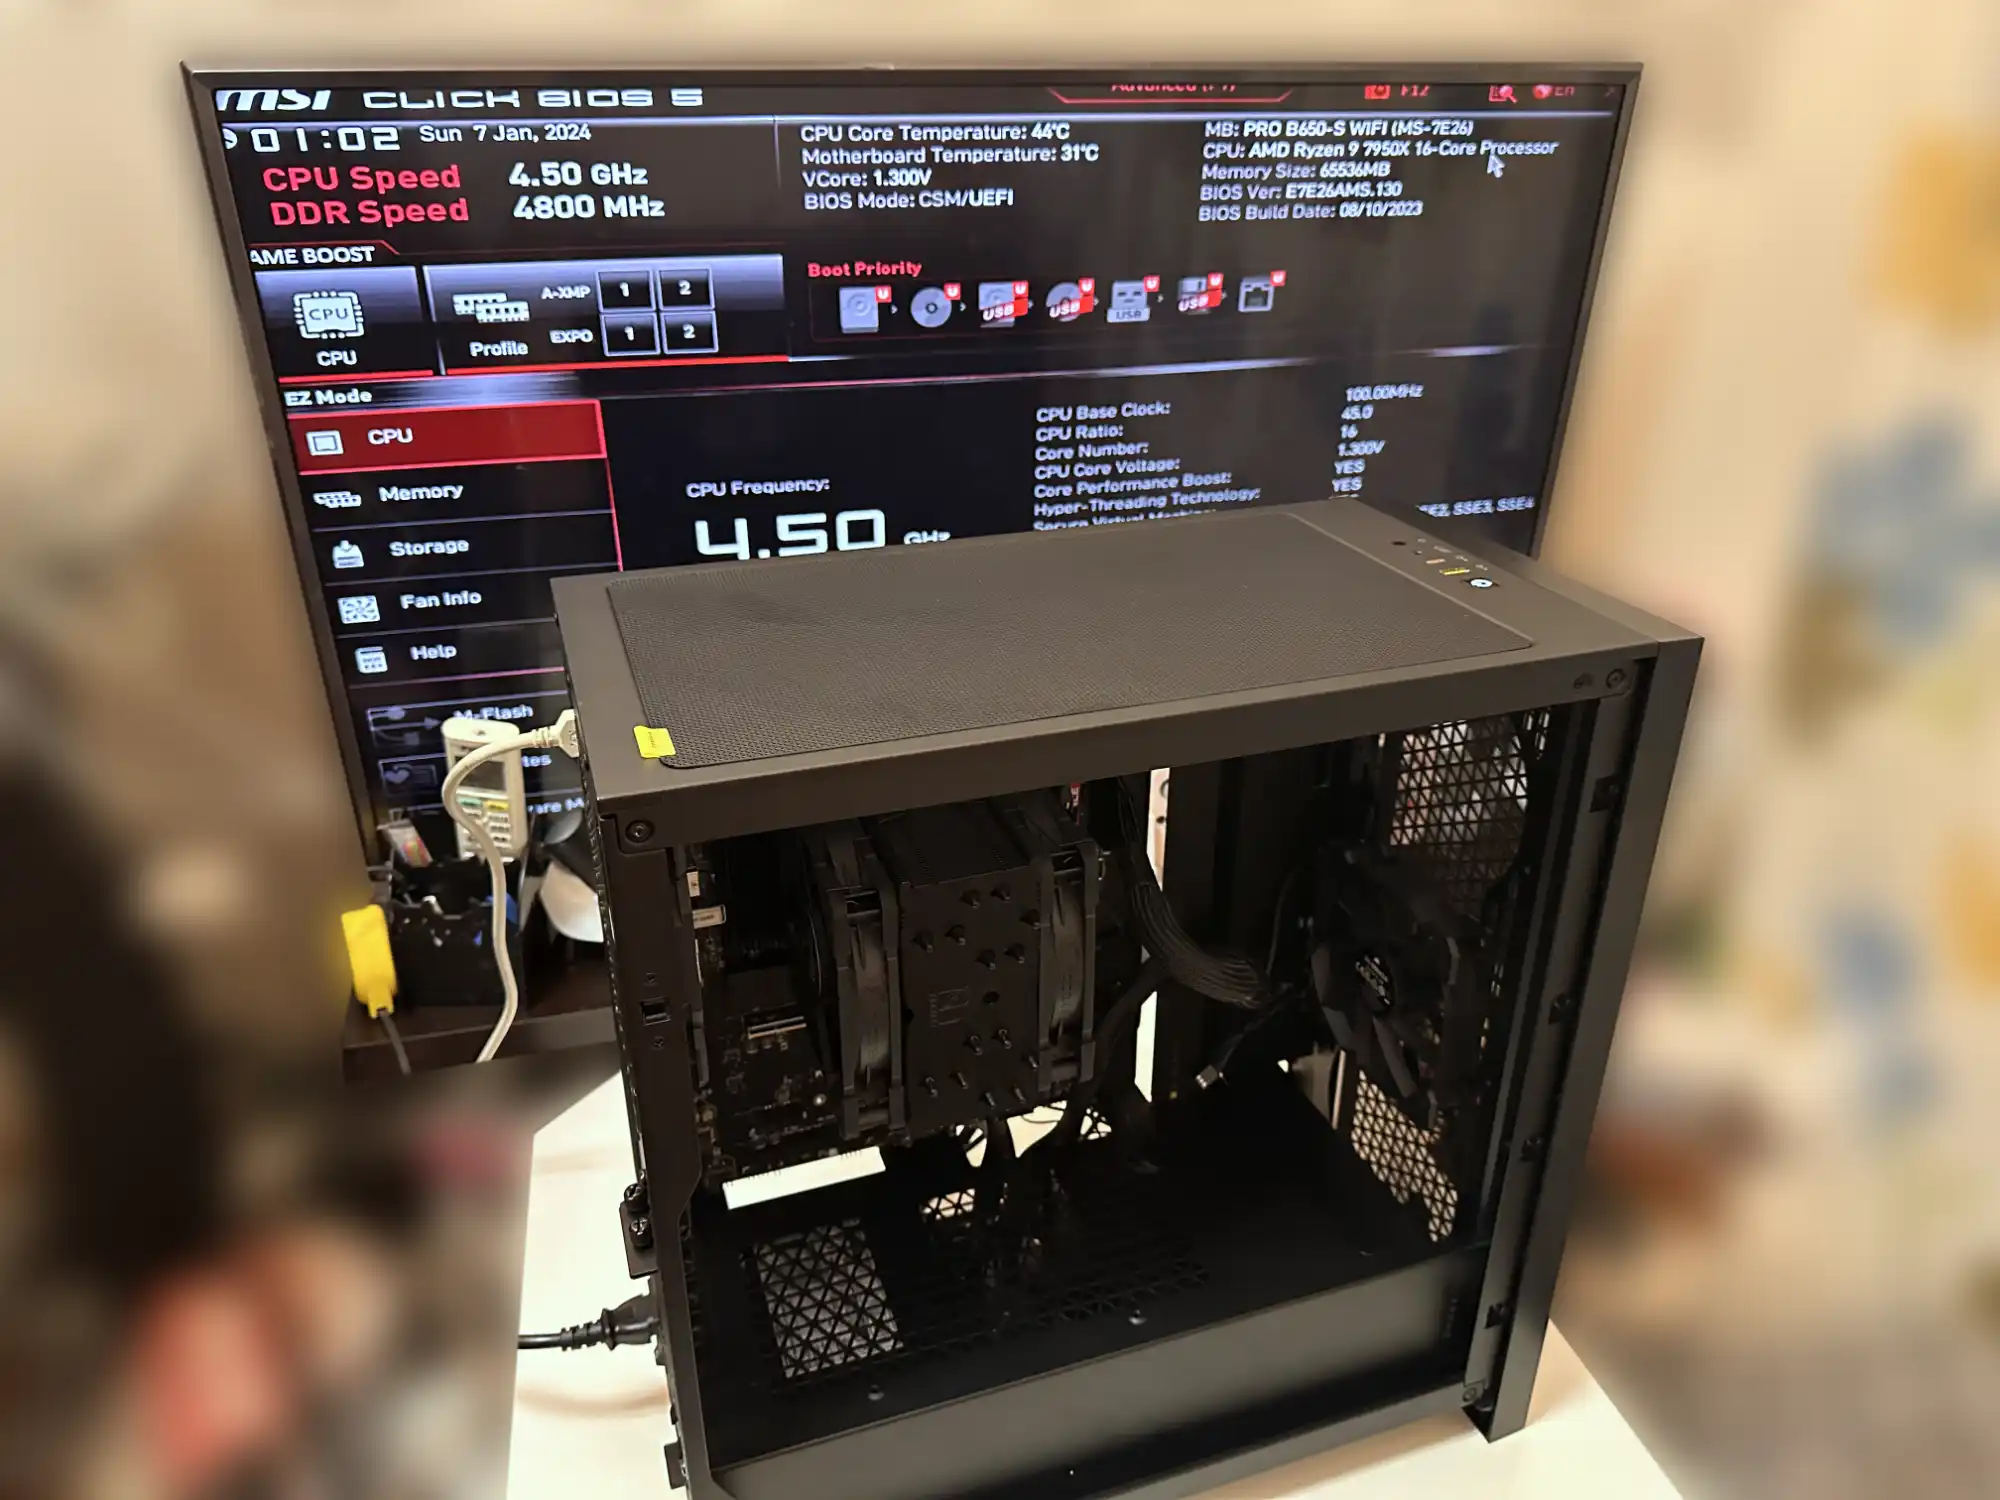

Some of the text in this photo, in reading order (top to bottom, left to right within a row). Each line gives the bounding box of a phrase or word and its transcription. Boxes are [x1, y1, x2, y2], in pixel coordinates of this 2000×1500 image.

[363, 90, 520, 108] CLICK
[537, 88, 653, 107] BIOS
[670, 88, 703, 106] 5
[419, 122, 592, 143] Sun 7 Jan, 2024
[800, 125, 842, 142] CPU
[848, 124, 894, 141] Core
[899, 123, 1027, 142] Temperature:
[1205, 119, 1474, 137] MB: PRO B650-S WIFI (MS-7E26)
[251, 126, 401, 152] 01:02
[1203, 138, 1560, 160] CPU: AMD Ryzen 9 7950X 16-Core Processor
[801, 147, 926, 165] Motherboard
[931, 145, 1056, 164] Temperature:
[263, 164, 461, 194] CPU Speed
[508, 161, 648, 187] 4.50 GHz
[802, 168, 932, 187] VCore: 1.300V
[1202, 161, 1391, 180] Memory Size: 65536MB
[804, 188, 1014, 210] BIOS Mode: CSM/UEFI
[1200, 181, 1403, 201] BIOS Ver: E7E26AMS.130
[270, 198, 469, 227] DDR Speed
[513, 194, 665, 219] 4800 MHz
[1199, 200, 1424, 221] BIOS Build Date: 08/10/2023
[302, 246, 375, 264] BOOST
[808, 260, 922, 278] Boot Priority
[541, 280, 692, 300] A-XMP 1 2
[309, 307, 349, 321] CPU
[982, 302, 1014, 321] USB
[1049, 301, 1081, 319] USB
[550, 324, 696, 343] EXPO 1 2
[316, 350, 357, 366] CPU
[469, 340, 528, 357] Profile
[283, 387, 372, 407] EZ Mode
[1036, 400, 1171, 422] CPU Base Clock:
[368, 428, 413, 445] CPU
[1035, 423, 1124, 442] CPU Ratio:
[1035, 441, 1149, 461] Core Number:
[1034, 457, 1180, 480] CPU Core Voltage:
[1334, 458, 1366, 475] YES
[379, 484, 464, 503] Memory
[686, 478, 830, 498] CPU Frequency:
[1034, 471, 1232, 498] Core Performance Boost:
[1331, 475, 1362, 492] YES
[1034, 494, 1167, 517] Hyper-Threading
[695, 508, 886, 561] 4.50
[390, 539, 469, 557] Storage
[400, 589, 482, 610] Fan Info
[411, 645, 457, 661] Help
